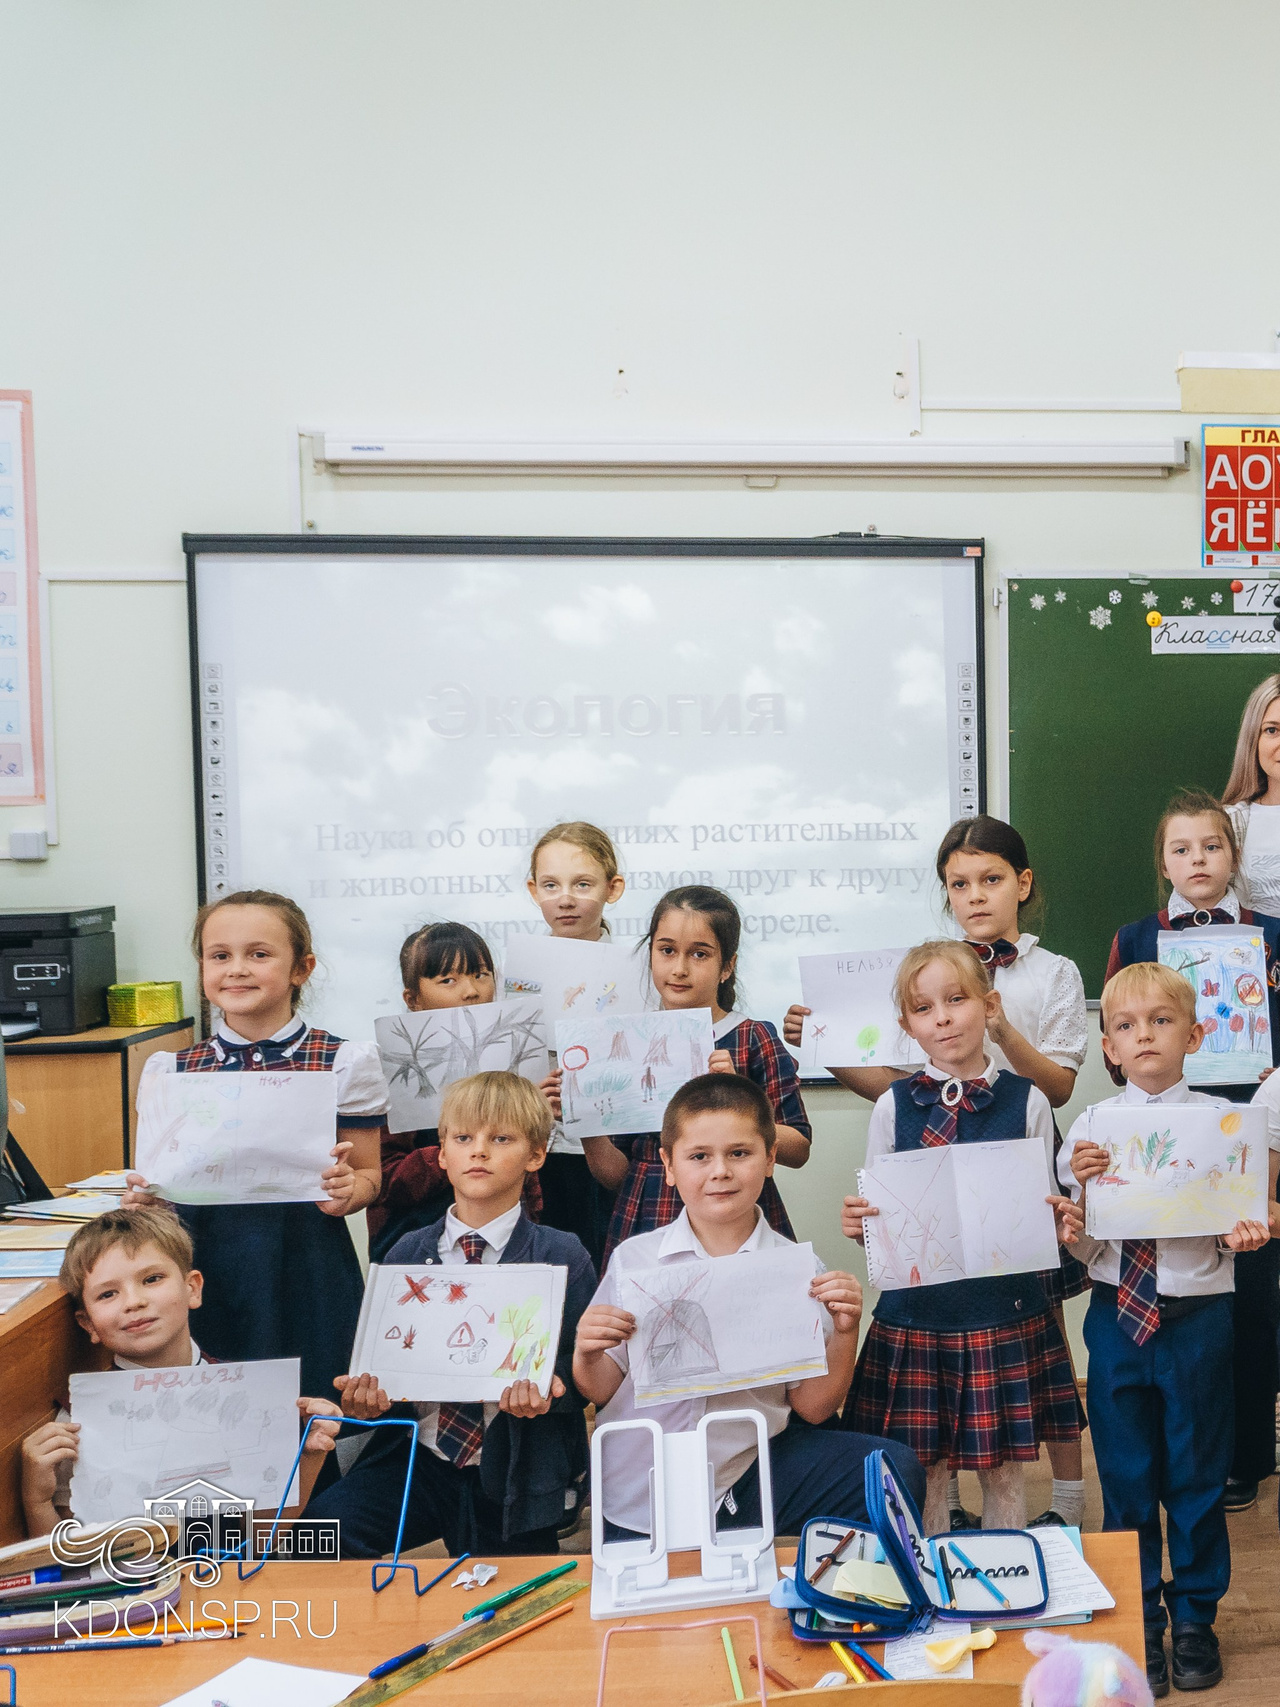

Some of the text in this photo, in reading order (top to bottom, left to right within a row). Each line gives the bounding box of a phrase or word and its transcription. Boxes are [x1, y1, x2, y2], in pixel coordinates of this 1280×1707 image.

[1244, 581, 1275, 608] 17
[1154, 615, 1277, 645] Классная
[314, 821, 415, 857] Наука
[426, 820, 467, 850] об
[689, 819, 919, 852] растительных
[309, 878, 330, 901] и
[338, 871, 514, 898] животных
[726, 864, 797, 896] друг
[807, 866, 827, 888] к
[836, 863, 928, 895] другу
[742, 913, 841, 942] среде.
